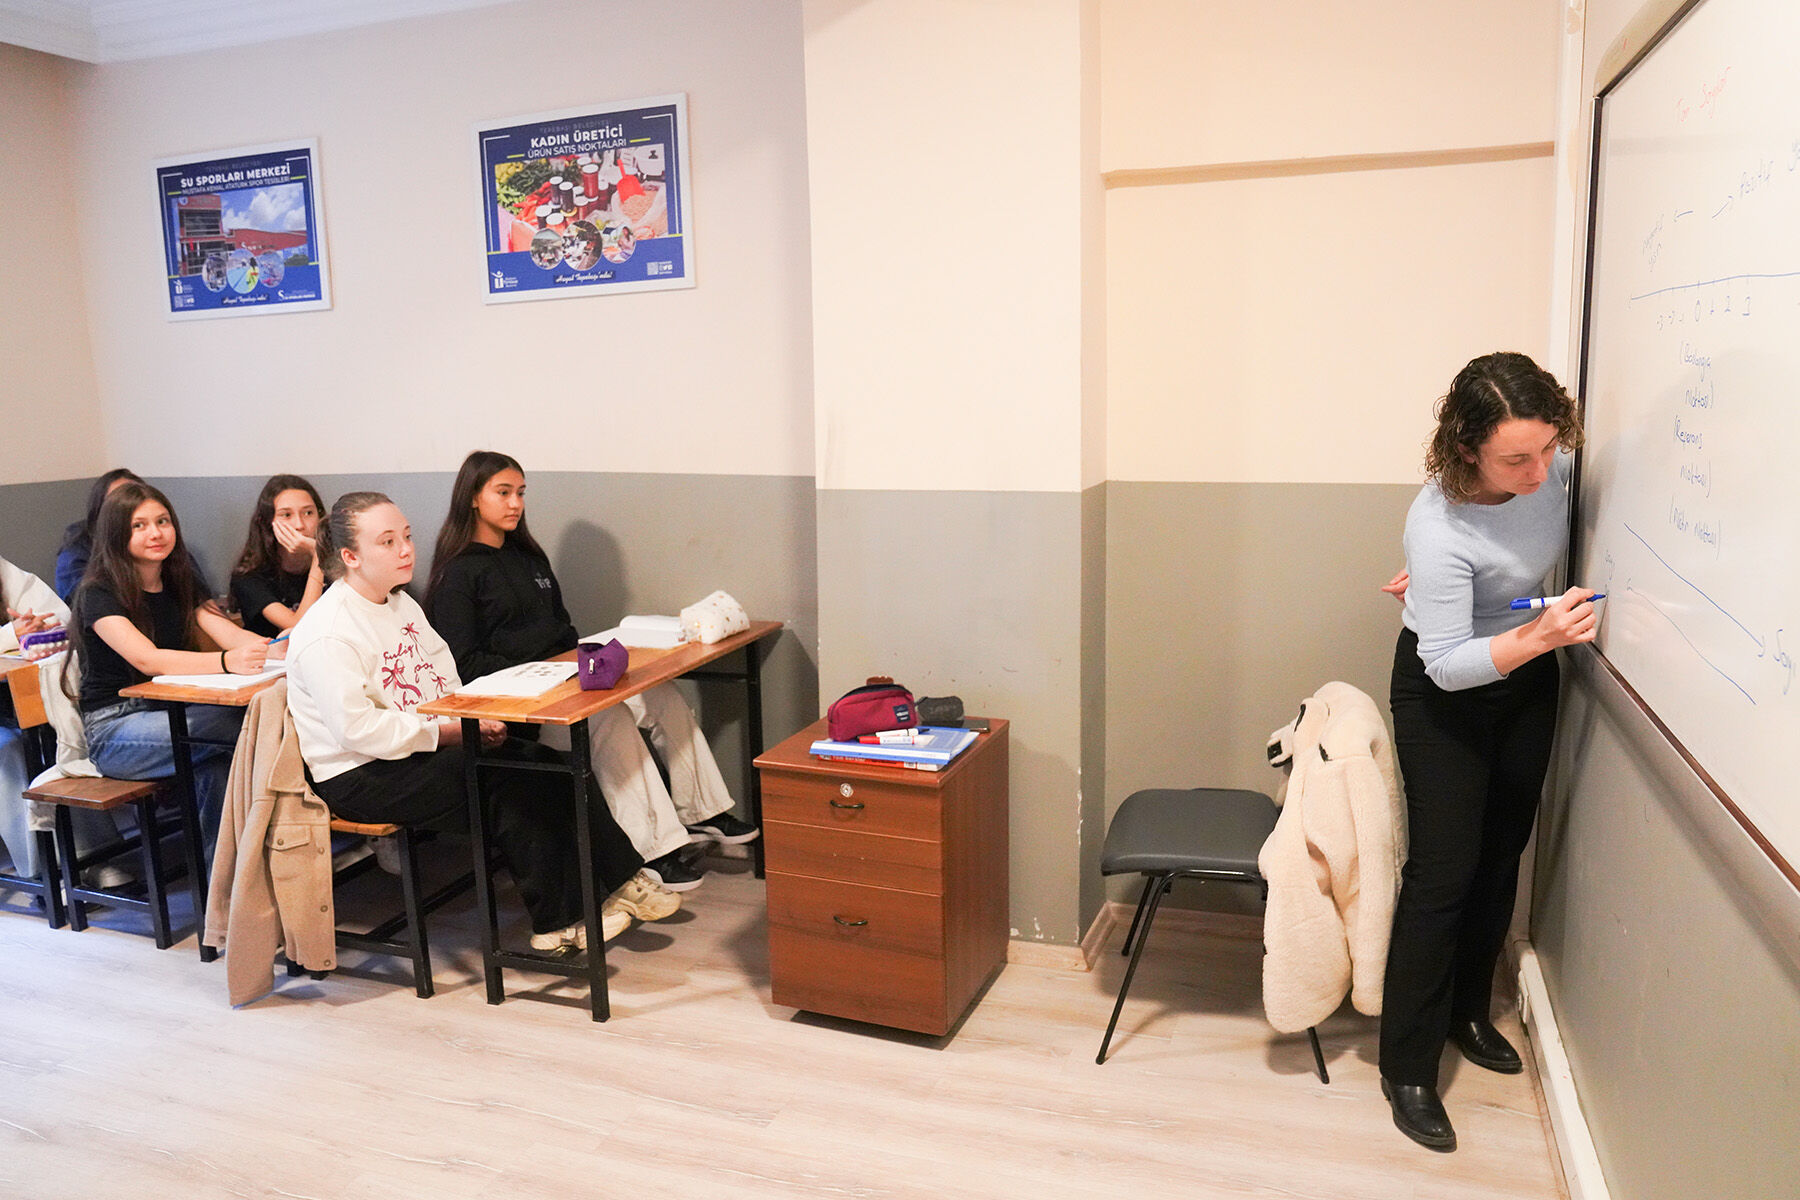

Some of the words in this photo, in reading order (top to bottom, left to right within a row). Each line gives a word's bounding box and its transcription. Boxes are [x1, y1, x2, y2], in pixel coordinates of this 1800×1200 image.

[527, 147, 553, 159] ÜRÜN
[553, 145, 577, 156] SATIŞ
[577, 138, 627, 153] NOKTALARI
[530, 133, 570, 149] KADIN
[573, 123, 623, 143] ÜRETİCİ
[180, 177, 194, 188] SU
[195, 171, 244, 187] SPORLARI
[246, 162, 291, 180] MERKEZİ
[1694, 298, 1701, 323] 0
